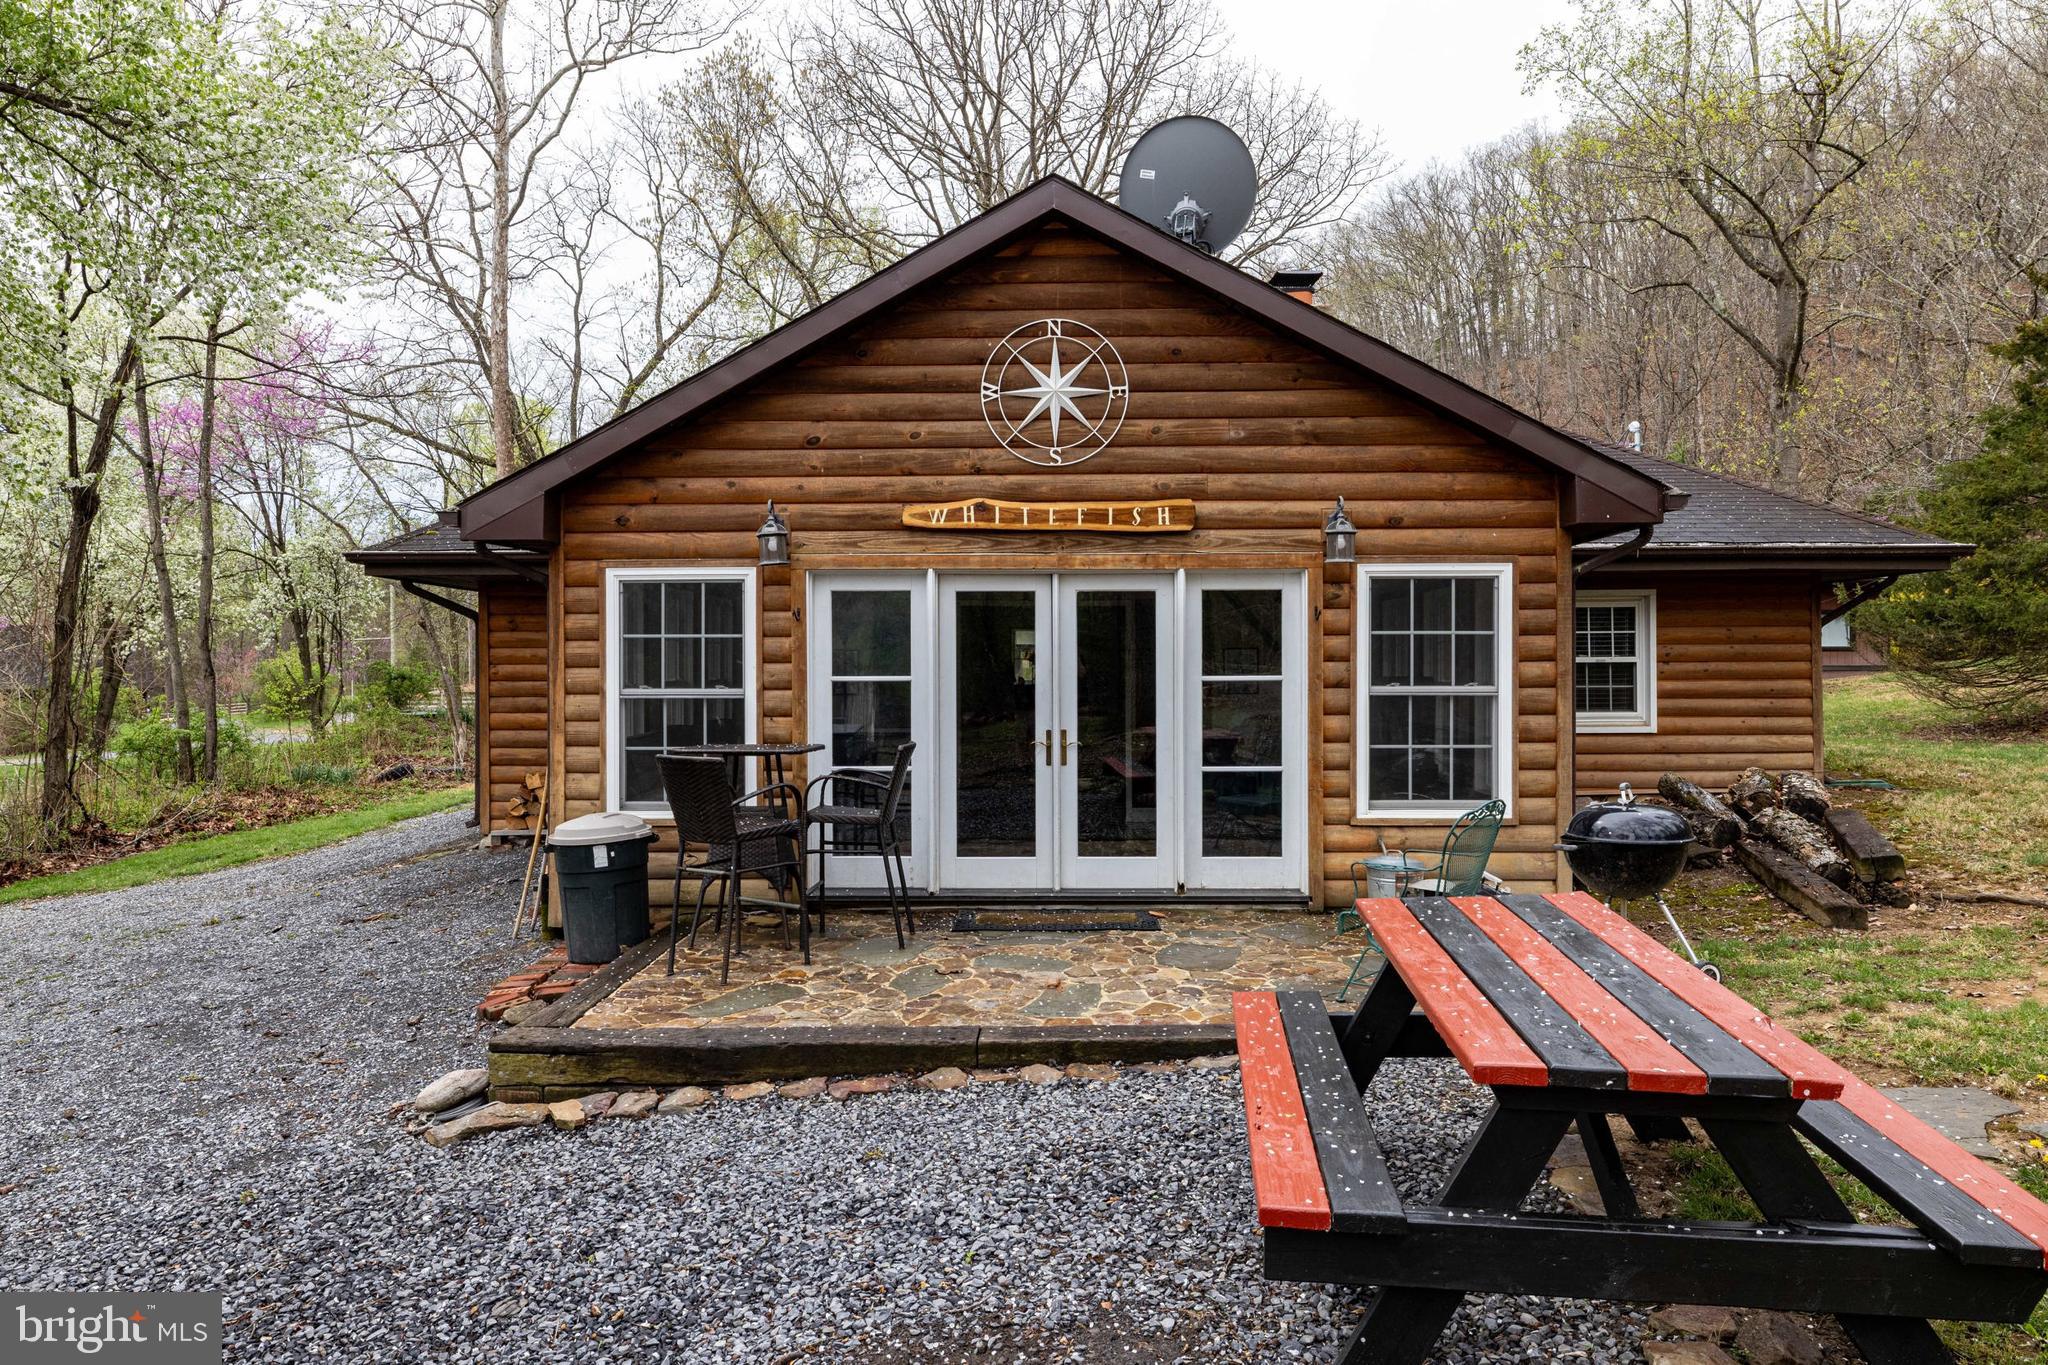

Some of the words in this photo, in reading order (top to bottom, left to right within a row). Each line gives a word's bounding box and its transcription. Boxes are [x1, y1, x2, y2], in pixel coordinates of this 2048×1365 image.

[1047, 320, 1062, 337] N
[982, 382, 1000, 402] W
[1110, 385, 1128, 399] E
[1049, 448, 1062, 465] S
[928, 505, 1170, 526] WHITEFISH
